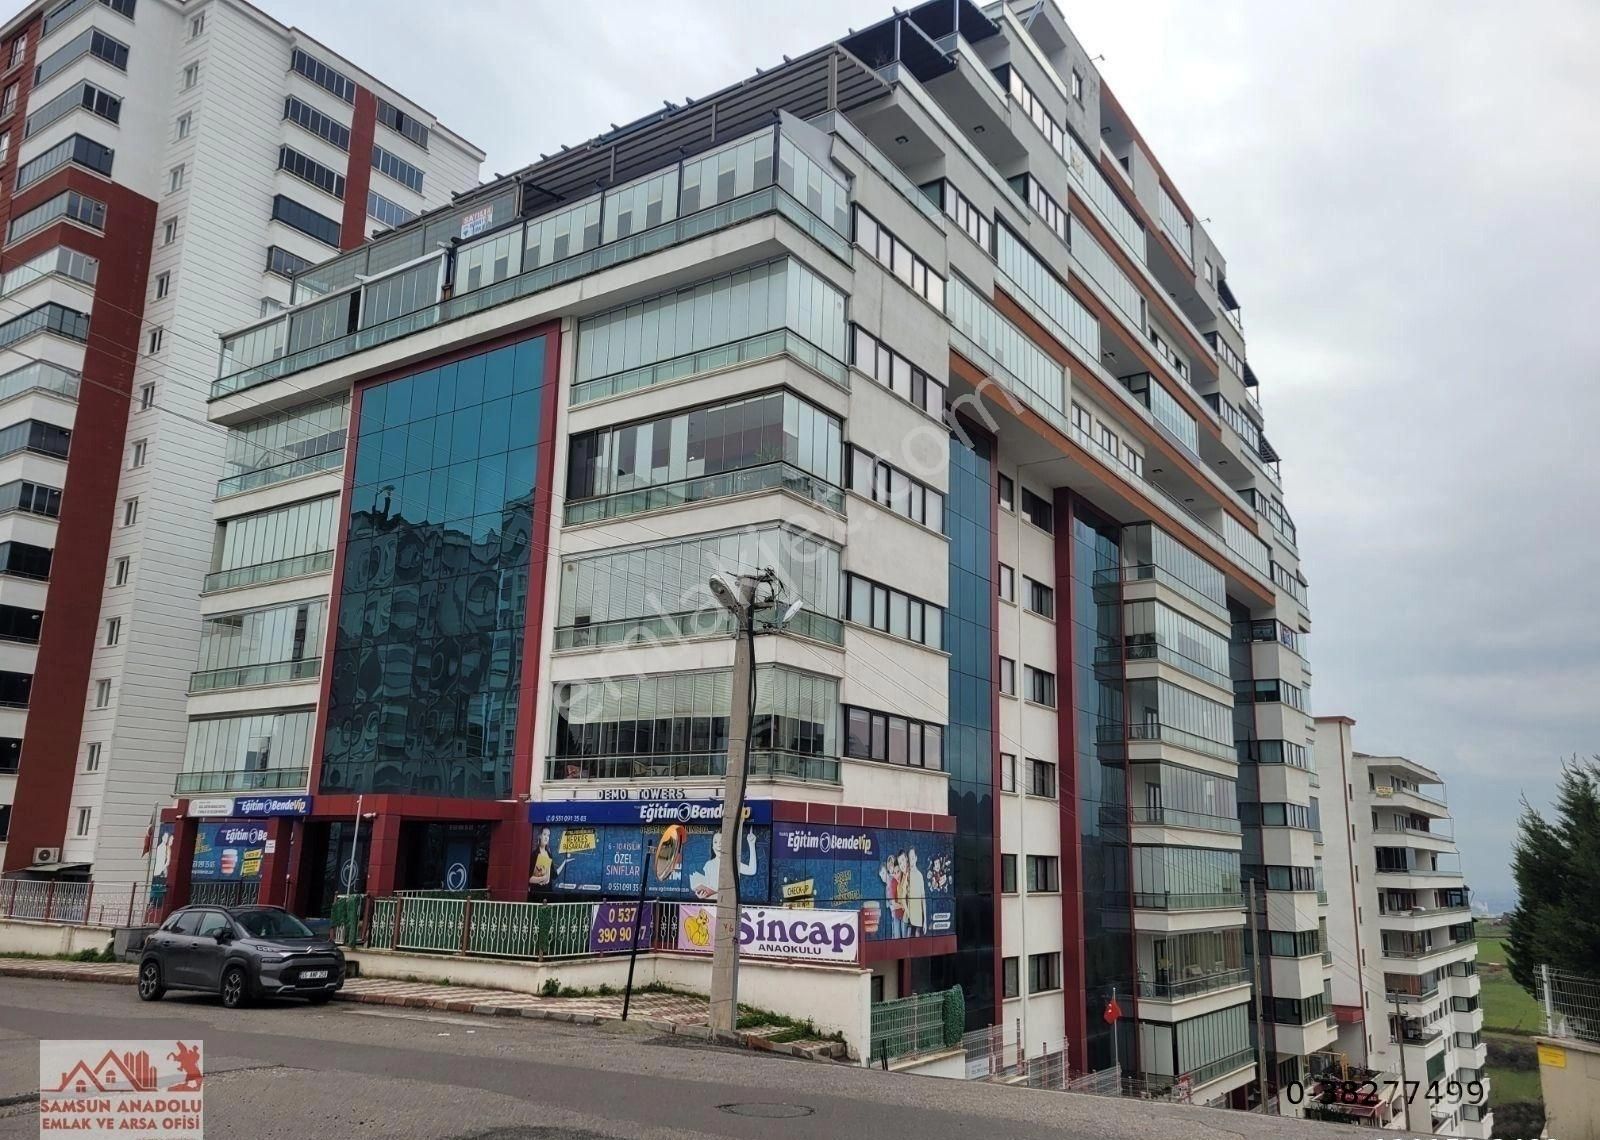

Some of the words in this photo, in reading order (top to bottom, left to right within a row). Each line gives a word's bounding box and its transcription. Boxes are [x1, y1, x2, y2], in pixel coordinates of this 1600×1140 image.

[597, 789, 628, 800] DEMO
[241, 798, 264, 814] Eğitim
[640, 802, 678, 822] Eğitim
[225, 827, 249, 844] Eğitim
[788, 831, 818, 851] Eğitim
[614, 852, 633, 864] ÖZEL
[606, 865, 640, 877] SINIFLAR
[613, 883, 622, 891] 551
[623, 883, 632, 891] 091
[633, 883, 639, 891] 35
[608, 908, 615, 923] 0
[618, 907, 637, 923] 537
[597, 928, 617, 943] 390
[619, 927, 632, 941] 90
[739, 911, 856, 953] Sincap
[758, 943, 822, 955] ANAOKULU
